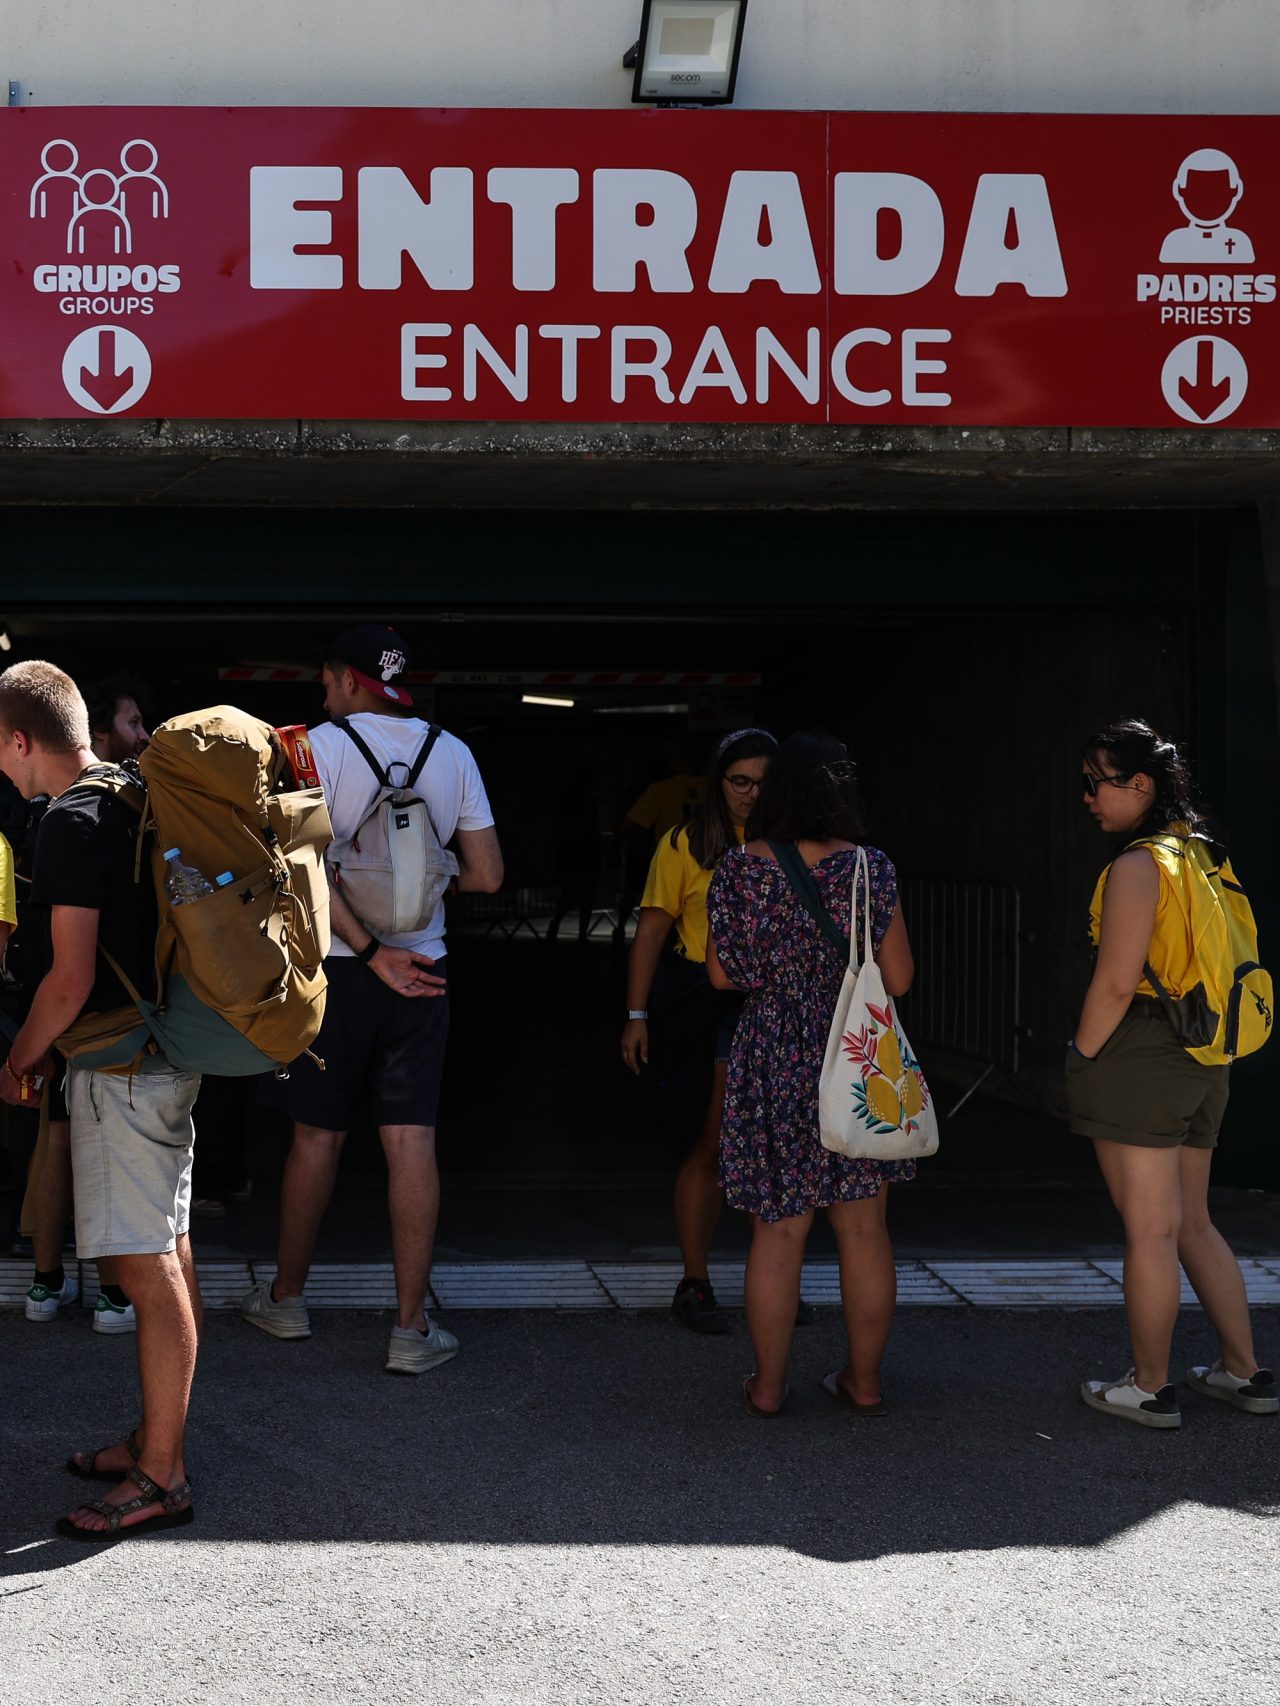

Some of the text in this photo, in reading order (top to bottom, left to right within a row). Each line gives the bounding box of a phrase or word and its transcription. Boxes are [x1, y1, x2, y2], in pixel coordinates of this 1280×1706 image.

[249, 165, 1068, 298] ENTRADA
[33, 264, 181, 293] GRUPOS
[1137, 274, 1277, 303] PADRES
[59, 296, 154, 315] GROUPS
[1161, 306, 1251, 325] PRIESTS
[400, 322, 952, 407] ENTRANCE
